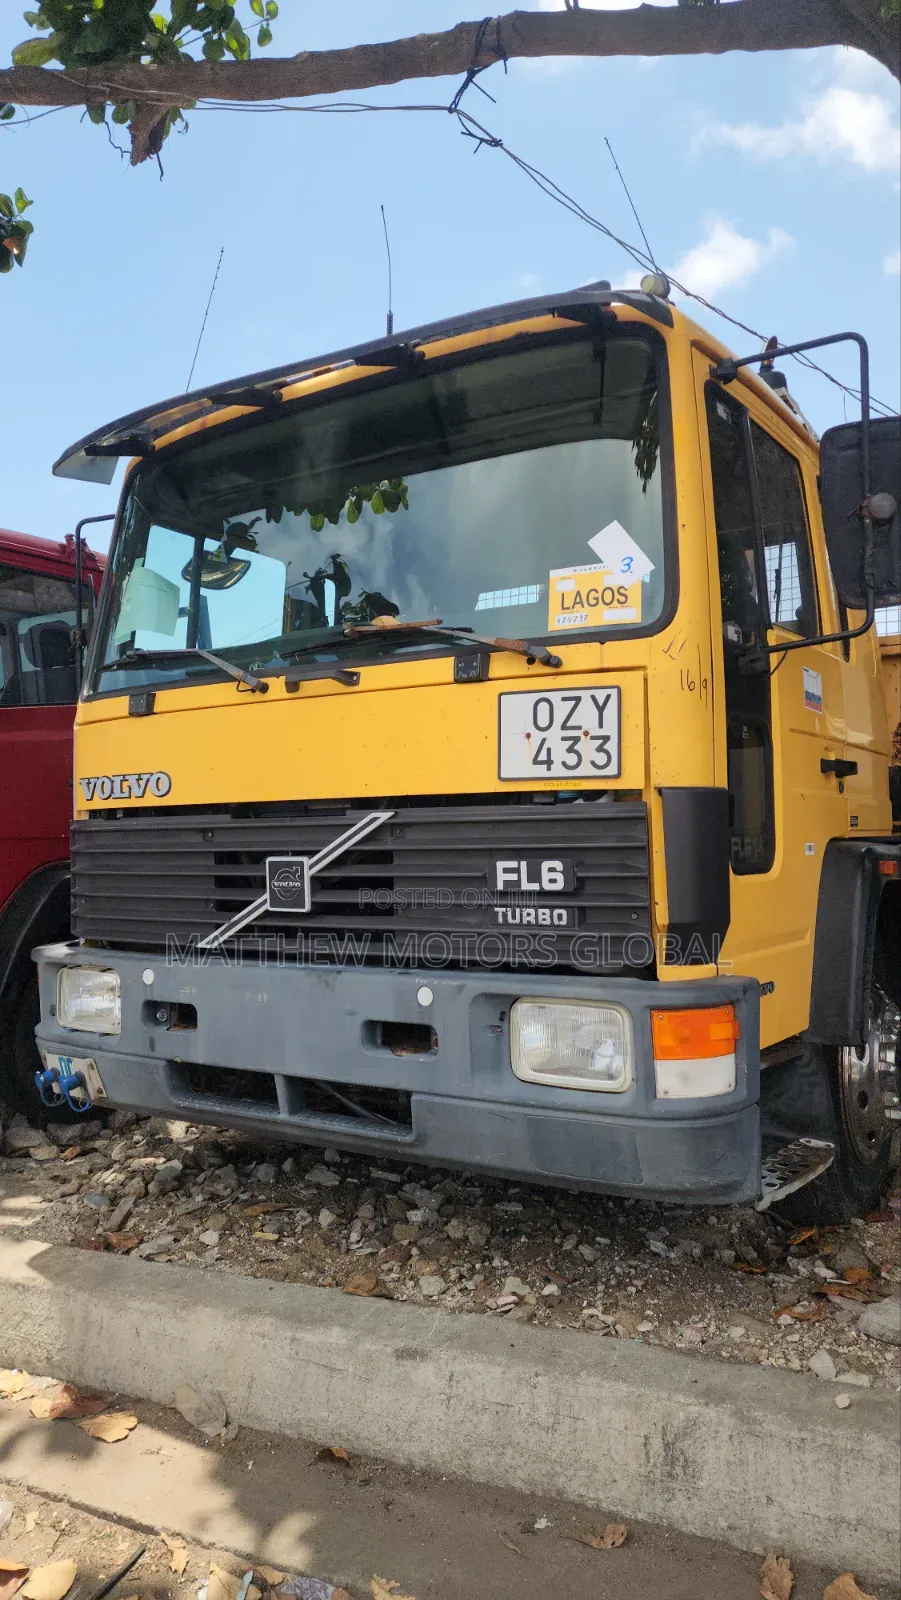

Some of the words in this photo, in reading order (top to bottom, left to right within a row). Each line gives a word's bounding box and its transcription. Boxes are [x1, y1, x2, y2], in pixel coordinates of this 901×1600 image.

[561, 585, 629, 611] LAGOS
[532, 694, 612, 732] OZY
[532, 735, 612, 772] 433
[79, 771, 171, 800] VOLVO
[495, 860, 565, 891] FL6
[494, 907, 568, 926] TURBO
